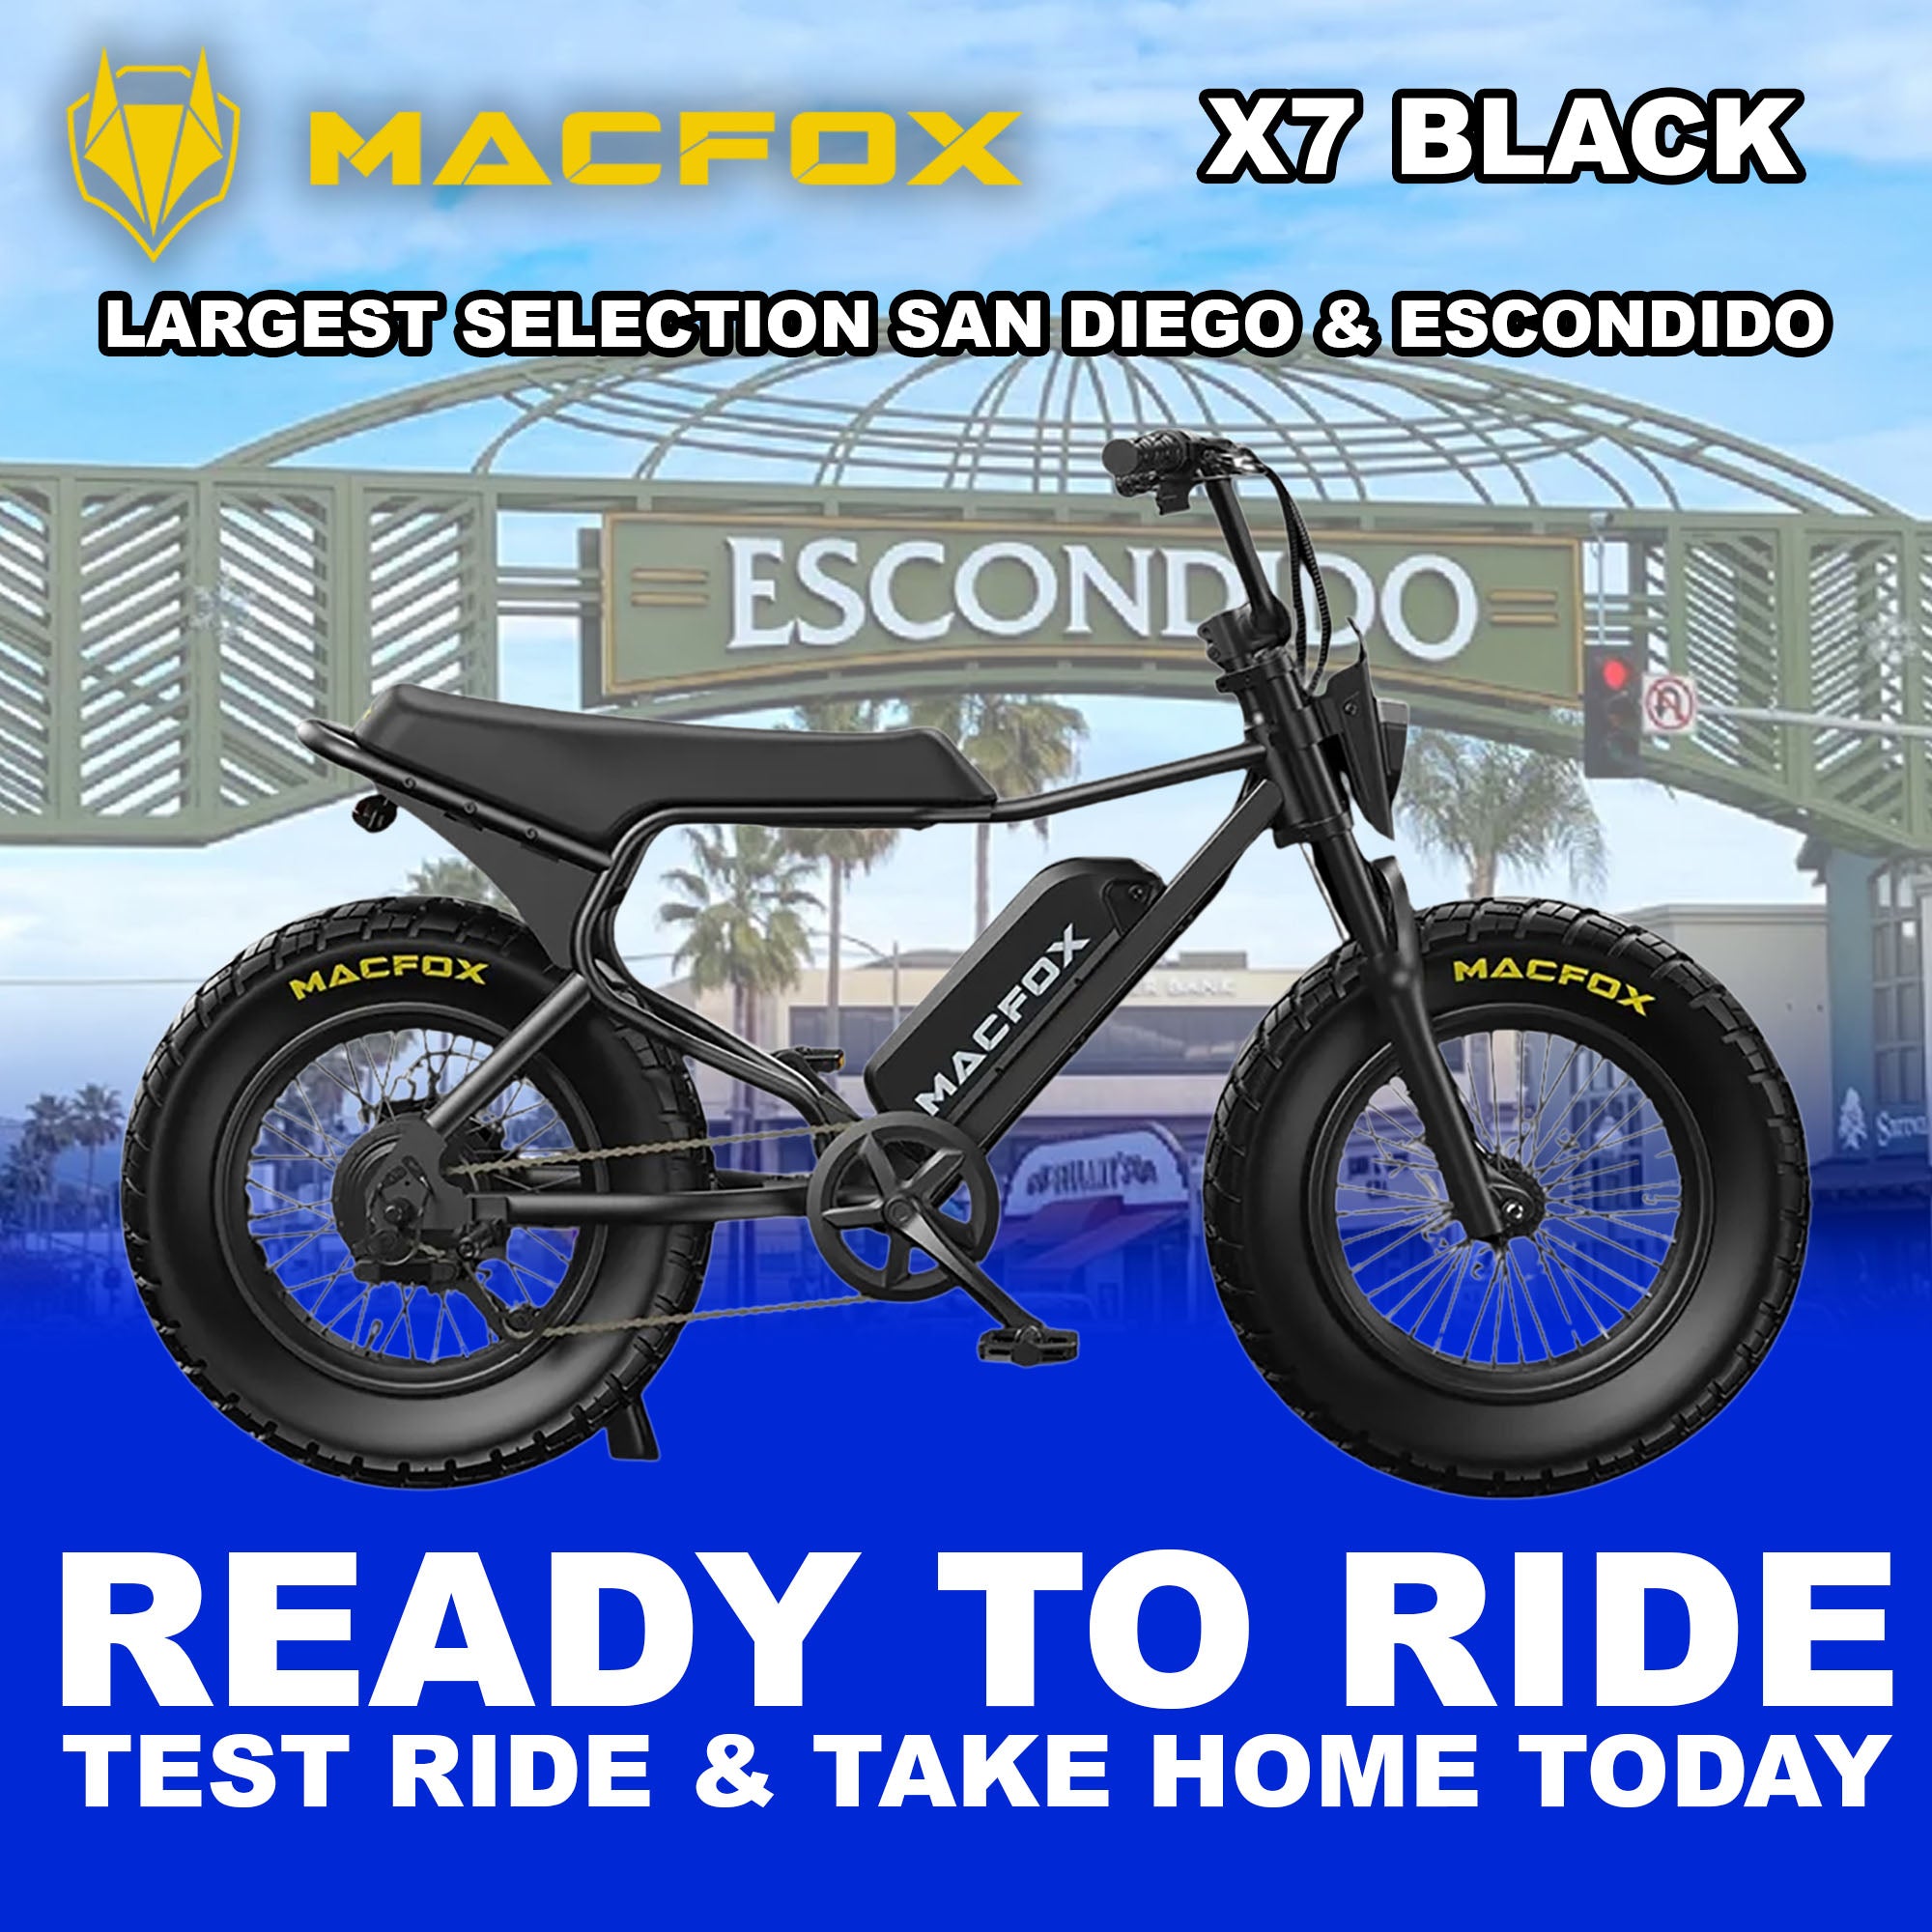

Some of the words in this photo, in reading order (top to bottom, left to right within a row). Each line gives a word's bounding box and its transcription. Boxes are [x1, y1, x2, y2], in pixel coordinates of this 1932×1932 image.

[289, 954, 490, 1001] MACFOX
[1453, 957, 1657, 1017] MACFOX
[915, 923, 1092, 1117] MACFOX
